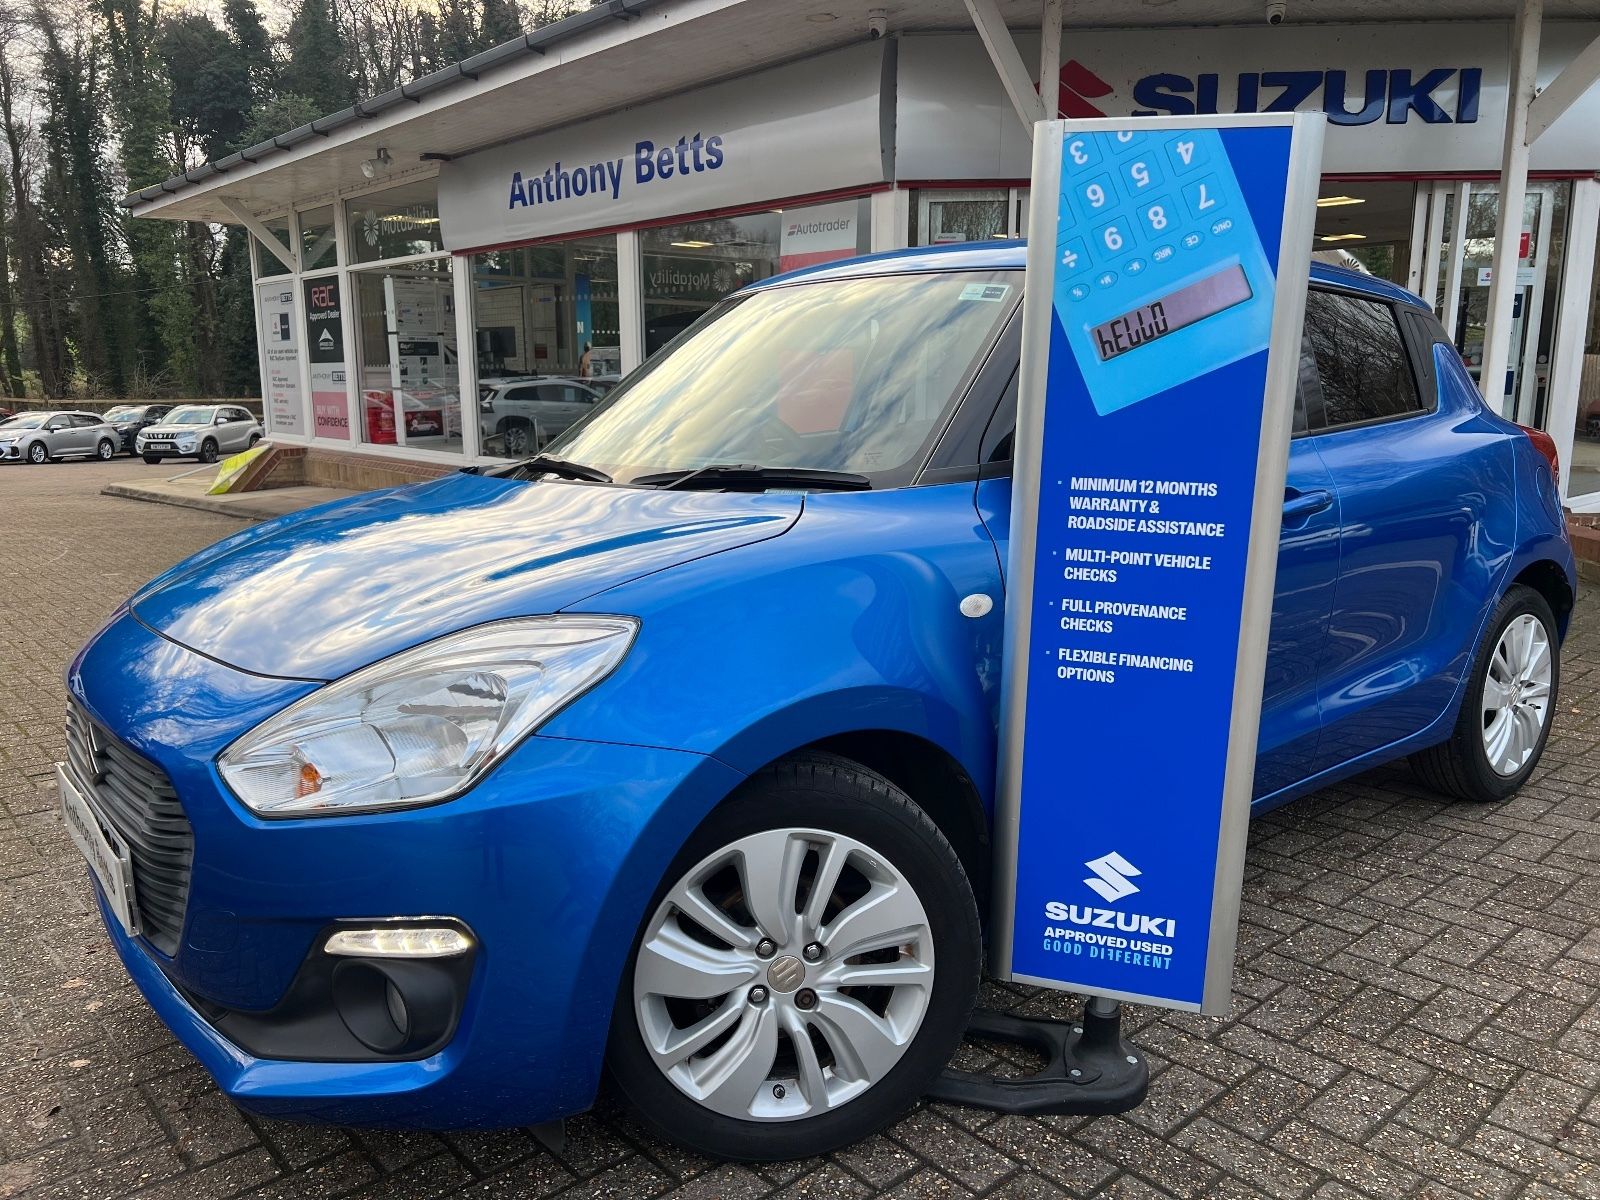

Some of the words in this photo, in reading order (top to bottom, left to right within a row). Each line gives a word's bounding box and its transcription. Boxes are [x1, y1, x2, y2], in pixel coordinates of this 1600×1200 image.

[1133, 68, 1483, 126] SUZUKI
[1069, 141, 1088, 165] 3
[1176, 141, 1194, 165] 4
[509, 159, 624, 209] Anthony
[635, 132, 724, 184] Betts
[1131, 162, 1150, 187] 5
[1199, 183, 1215, 210] 7
[381, 205, 434, 236] Motability
[796, 218, 850, 236] Autotrader
[1148, 205, 1167, 230] 8
[309, 311, 327, 321] Approved
[328, 309, 340, 319] Dealer
[317, 416, 348, 427] CONFIDENCE
[1070, 477, 1137, 493] MINIMUM
[1138, 481, 1154, 494] 12
[1155, 481, 1218, 497] MONTHS
[1069, 497, 1148, 513] WARRANTY
[1149, 500, 1160, 514] &
[1067, 516, 1136, 532] ROADSIDE
[1137, 519, 1225, 537] ASSISTANCE
[1065, 548, 1152, 566] MULTI-POINT
[1154, 553, 1211, 570] VEHICLE
[1064, 567, 1117, 583] CHECKS
[1061, 599, 1093, 614] FULL
[1094, 601, 1187, 621] PROVENANCE
[1060, 617, 1113, 633] CHECKS
[1058, 648, 1117, 665] FLEXIBLE
[1118, 653, 1194, 673] FINANCING
[1057, 666, 1115, 683] OPTIONS
[1044, 901, 1176, 938] SUZUKI
[1044, 926, 1127, 949] APPROVED
[1129, 940, 1173, 956] USED
[1043, 938, 1082, 956] GOOD
[1089, 945, 1172, 970] DIFFERENT
